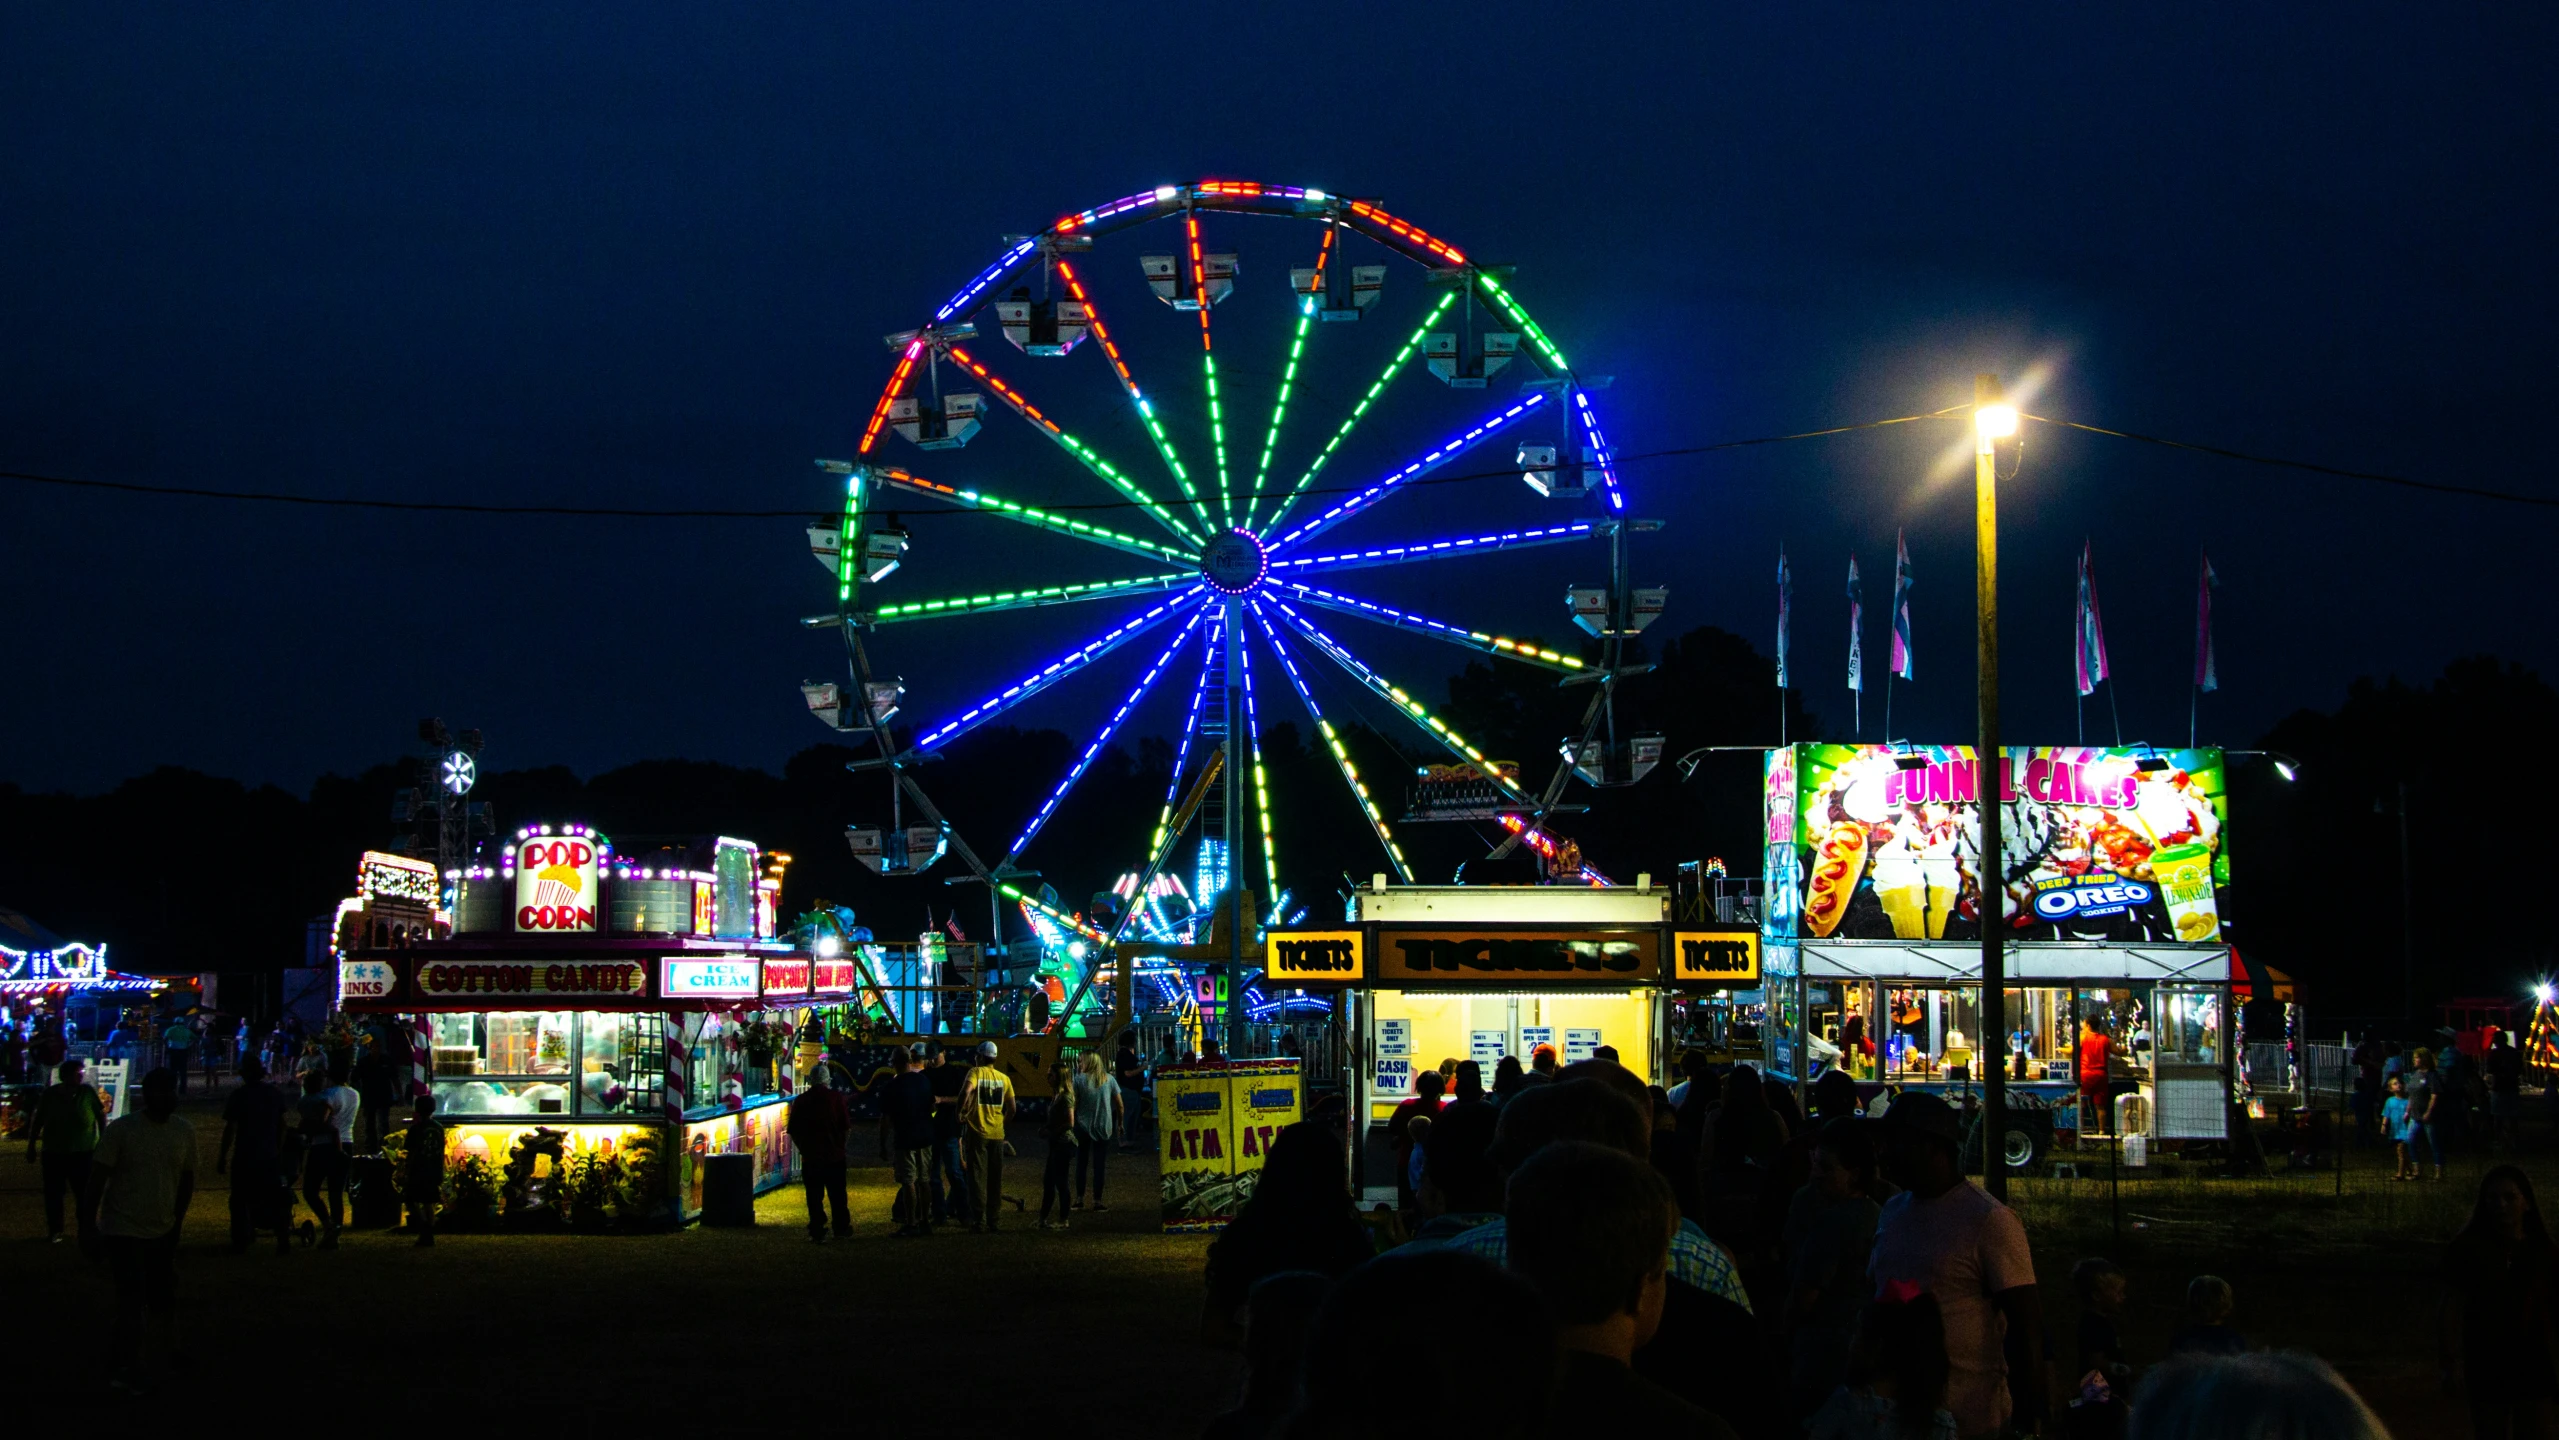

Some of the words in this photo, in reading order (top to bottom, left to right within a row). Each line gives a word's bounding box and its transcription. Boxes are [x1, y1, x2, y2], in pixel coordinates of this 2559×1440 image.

[1885, 758, 2017, 805] FUNNL
[2025, 758, 2138, 809] CAKES
[524, 841, 592, 869] POP
[2037, 877, 2072, 891] DEEP
[2077, 873, 2117, 885] FRIED
[2165, 882, 2213, 906] LEMONADE
[2038, 886, 2148, 914] OREO
[2081, 905, 2125, 917] COOKIES
[518, 904, 596, 930] CORN
[1276, 939, 1354, 971] TICKETS
[1395, 939, 1640, 971] TICKETS
[1681, 940, 1750, 972] TICKETS
[428, 964, 534, 992] COTTON
[545, 964, 636, 992] CANDY
[690, 975, 750, 987] CREAM
[706, 965, 740, 974] ICE
[1377, 1060, 1408, 1073] CASH
[2049, 1061, 2070, 1070] CASH
[2049, 1071, 2069, 1080] ONLY
[1377, 1074, 1407, 1088] ONLY
[1169, 1128, 1223, 1160] ATM
